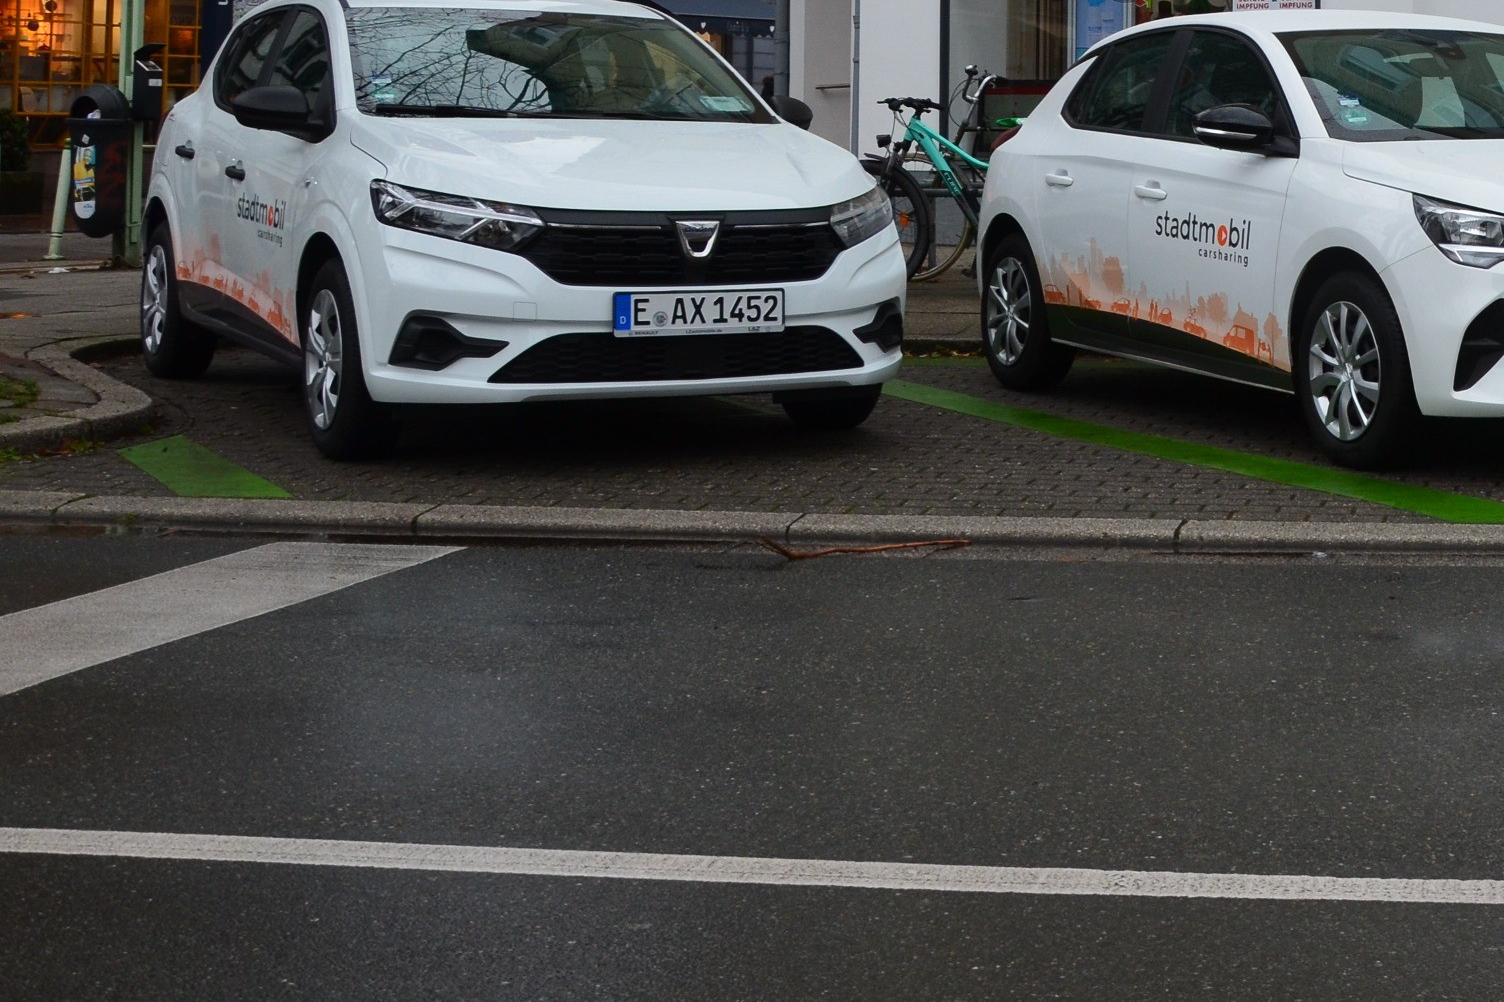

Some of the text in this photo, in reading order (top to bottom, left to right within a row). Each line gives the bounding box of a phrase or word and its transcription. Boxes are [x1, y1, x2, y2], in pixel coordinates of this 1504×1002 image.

[1236, 2, 1270, 10] IMPFUNG
[1279, 1, 1313, 9] IMPFUNG
[237, 192, 287, 230] stadtmobil
[257, 229, 283, 248] carsharing
[1155, 210, 1251, 250] stadtmobil
[1198, 248, 1249, 267] carsharing
[619, 316, 627, 325] D
[633, 298, 650, 326] E
